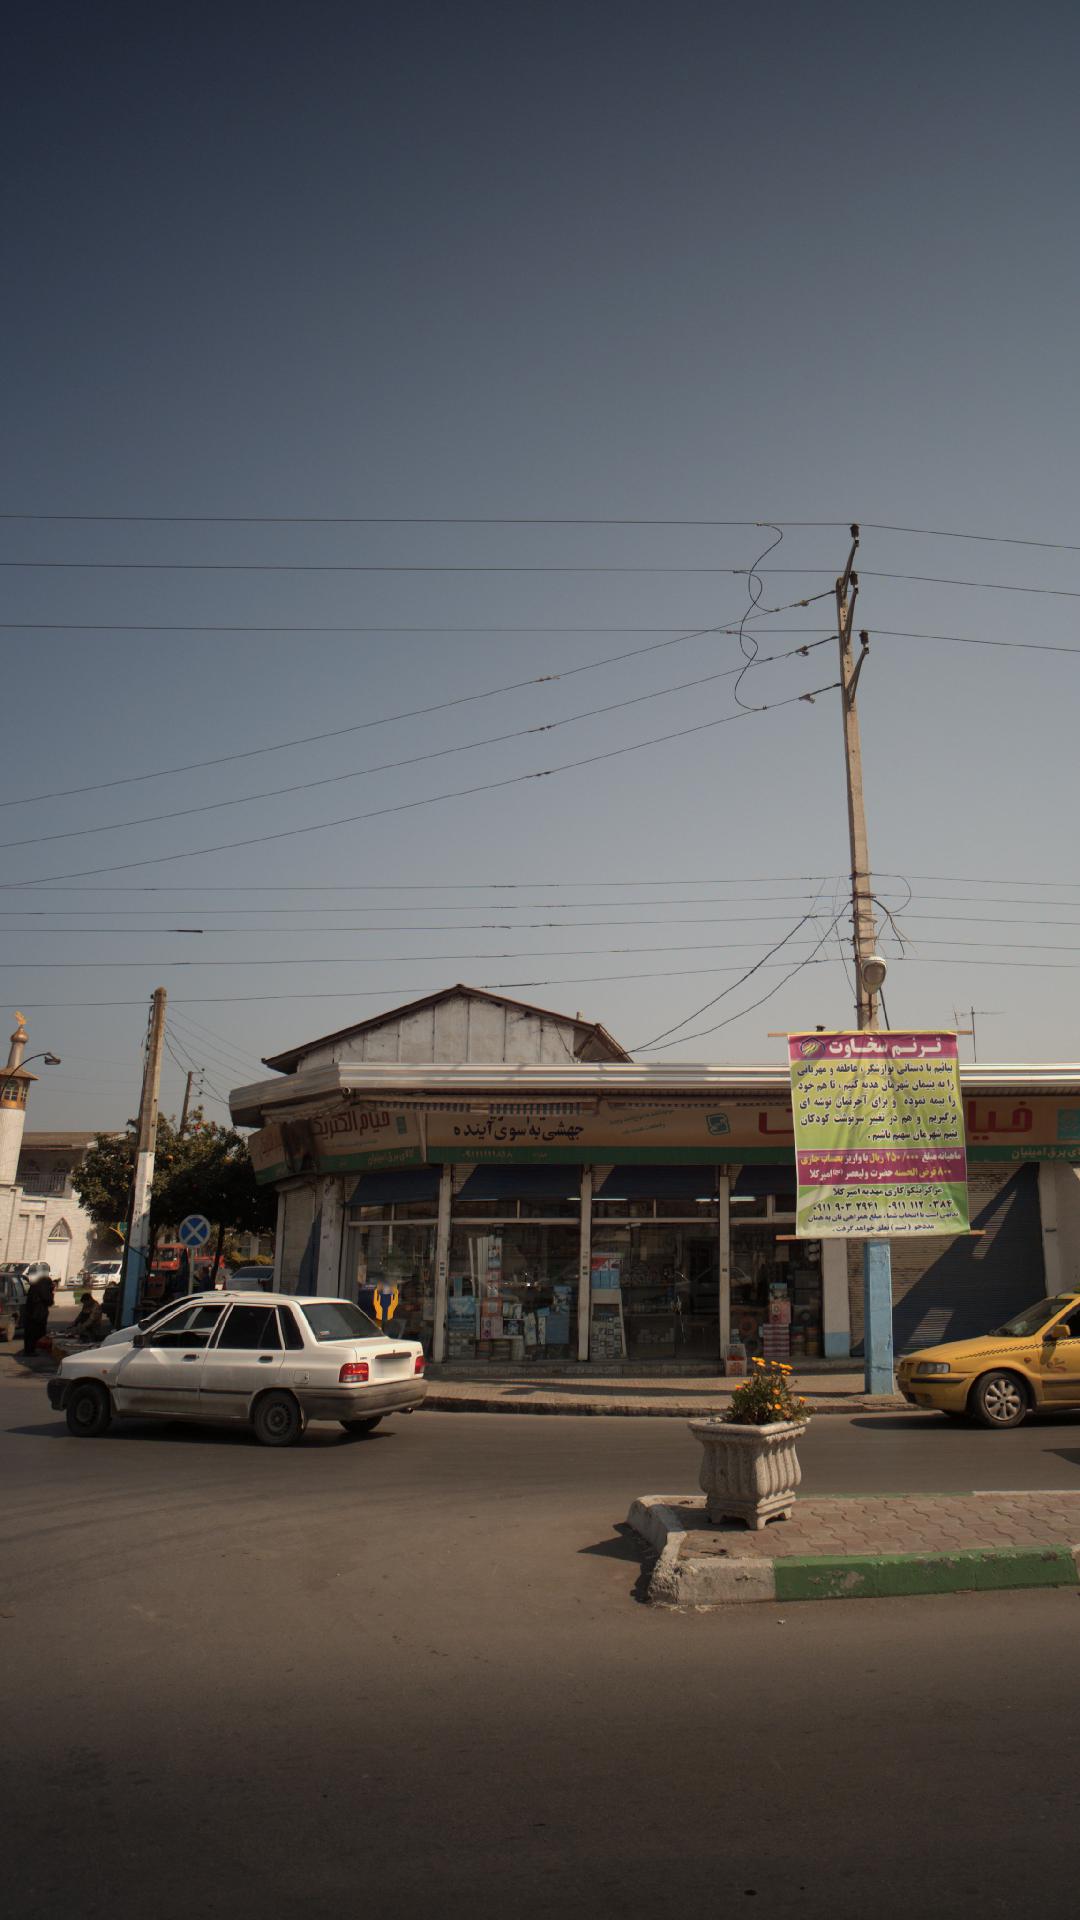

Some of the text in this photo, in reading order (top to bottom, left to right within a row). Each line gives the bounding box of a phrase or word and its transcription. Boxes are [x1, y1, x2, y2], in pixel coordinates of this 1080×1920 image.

[829, 1037, 941, 1058] ترنم سخاوت
[797, 1064, 826, 1076] مهربانی
[897, 1065, 924, 1075] دستانی
[925, 1064, 932, 1072] با
[798, 1081, 814, 1092] خود
[816, 1082, 827, 1092] هم
[829, 1080, 835, 1088] تا
[861, 1081, 879, 1089] هدیه
[912, 1080, 935, 1090] یتیمان
[947, 1080, 954, 1090] را
[799, 1097, 810, 1109] ای
[814, 1098, 832, 1109] توشه
[836, 1095, 867, 1109] آخرتمان
[871, 1096, 888, 1108] برای
[904, 1098, 926, 1108] نموده
[930, 1097, 945, 1105] بیمه
[949, 1095, 956, 1106] را
[801, 1113, 830, 1125] کودکان
[834, 1116, 864, 1125] سرنوشت
[869, 1116, 885, 1125] تغییر
[889, 1115, 898, 1125] در
[901, 1115, 912, 1125] هم
[453, 1120, 584, 1141] جهشی به سوی آینده
[893, 1131, 910, 1140] سهیم
[800, 1154, 819, 1165] جاری
[821, 1154, 843, 1163] بحساب
[845, 1153, 862, 1164] واریز
[862, 1153, 868, 1161] با
[871, 1153, 884, 1164] ریال
[921, 1152, 937, 1163] مبلغ
[937, 1151, 961, 1160] ماهیانه
[845, 1169, 869, 1180] ولیعصر
[870, 1168, 893, 1178] حضرت
[894, 1168, 918, 1177] الحسنه
[919, 1168, 937, 1178] قرض
[924, 1186, 943, 1195] مرکز
[813, 1202, 831, 1211] ۰۹۱۱
[835, 1201, 851, 1210] ۹۰۳
[888, 1201, 906, 1209] ۰۹۱۱
[910, 1201, 924, 1209] ۱۱۲
[808, 1215, 824, 1223] همان
[869, 1213, 883, 1221] مبلغ
